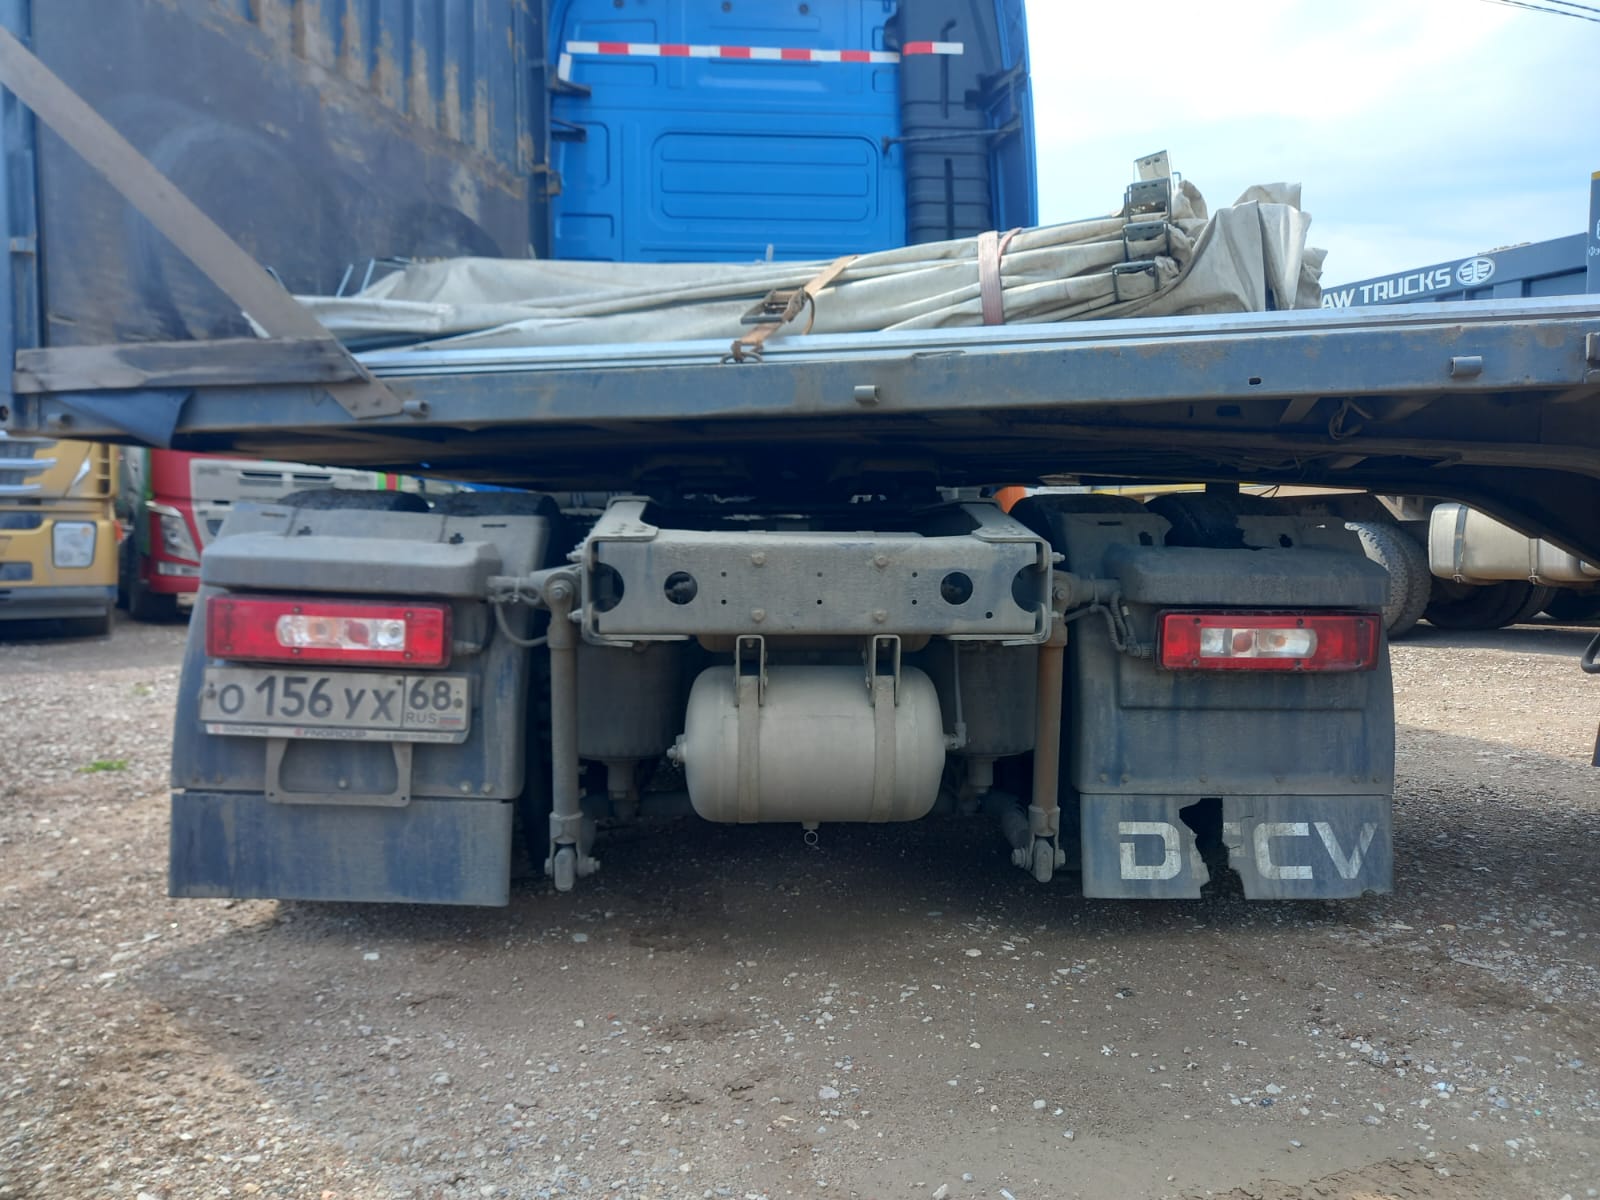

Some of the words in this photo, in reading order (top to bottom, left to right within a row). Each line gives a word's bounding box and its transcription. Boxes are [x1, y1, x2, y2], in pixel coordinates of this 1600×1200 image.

[1322, 288, 1355, 309] AW
[1360, 268, 1450, 304] TRUCKS
[409, 679, 451, 711] 68
[405, 712, 437, 724] RUS
